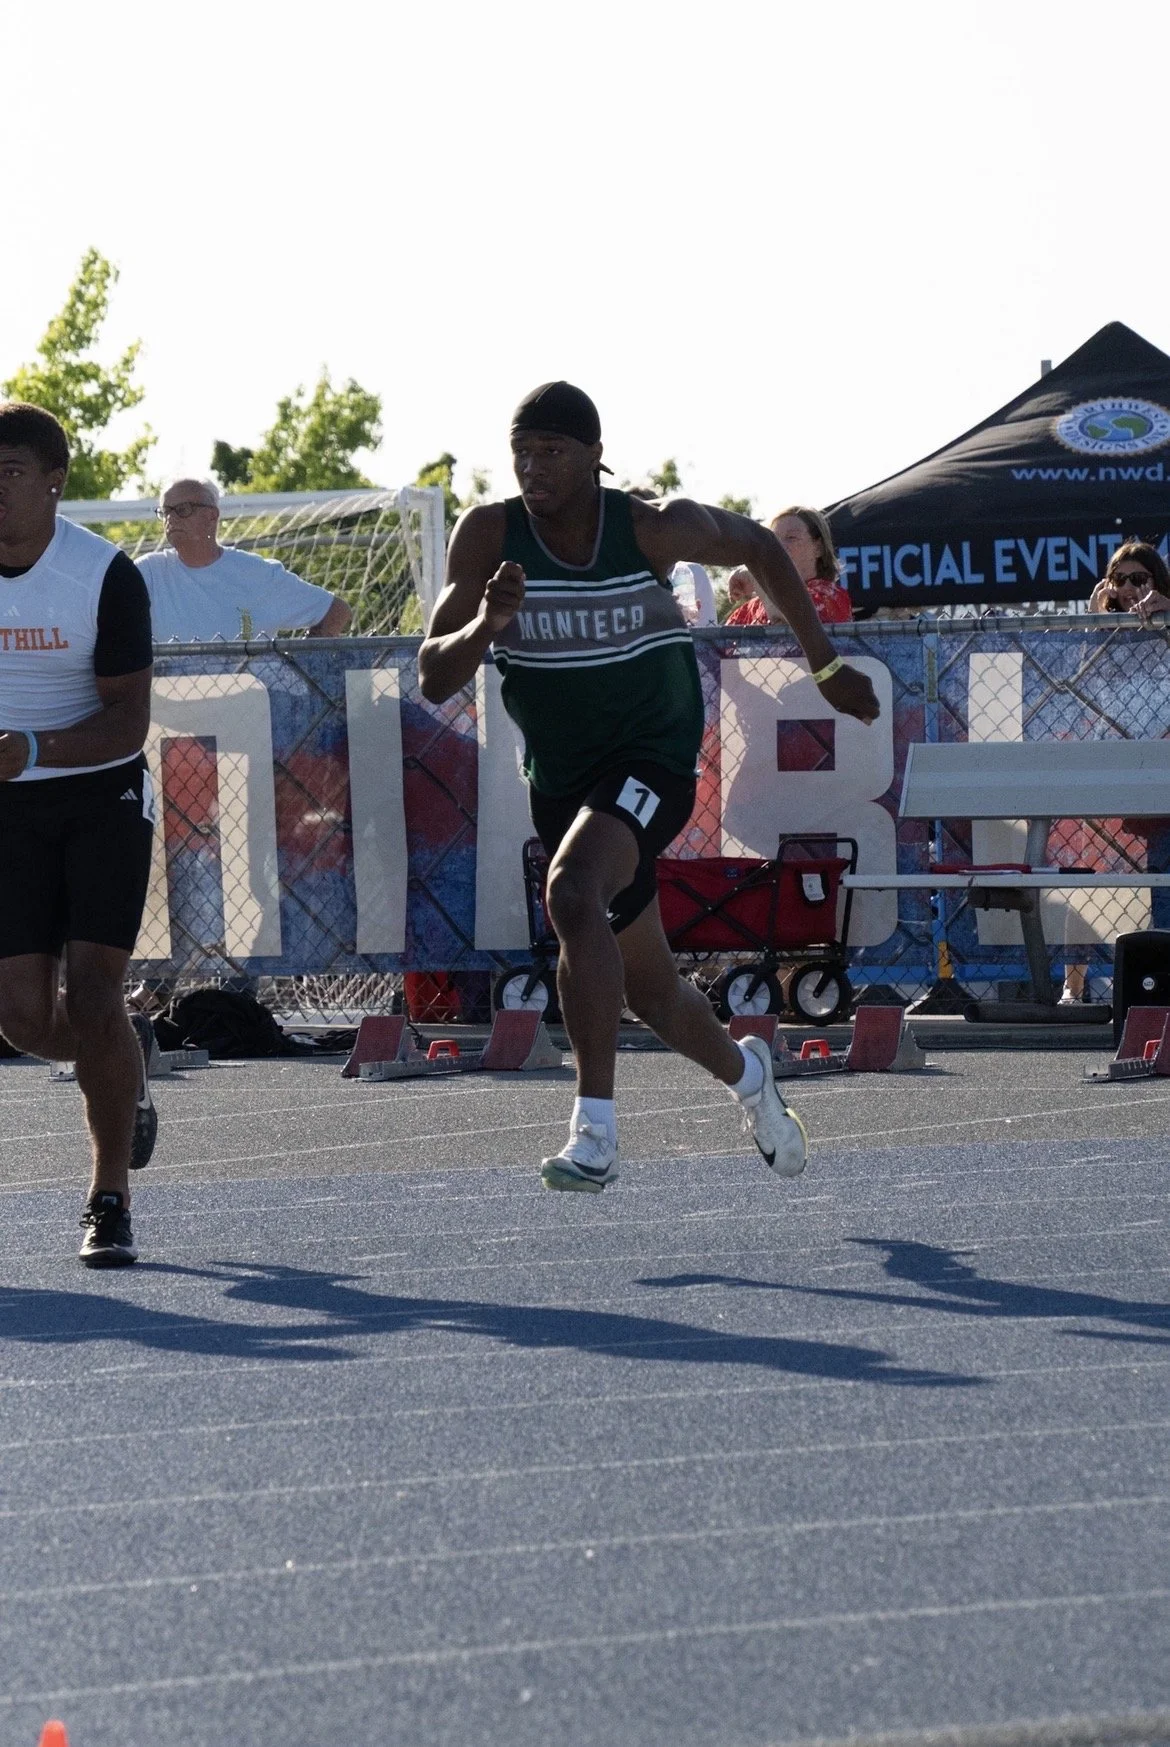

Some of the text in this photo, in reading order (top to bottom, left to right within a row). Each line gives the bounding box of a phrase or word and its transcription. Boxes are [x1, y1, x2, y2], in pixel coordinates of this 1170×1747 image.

[838, 540, 985, 590] FFICIAL
[994, 534, 1123, 583] EVENT
[0, 627, 69, 651] THILL
[517, 605, 644, 641] MANTECA
[634, 788, 650, 817] 1
